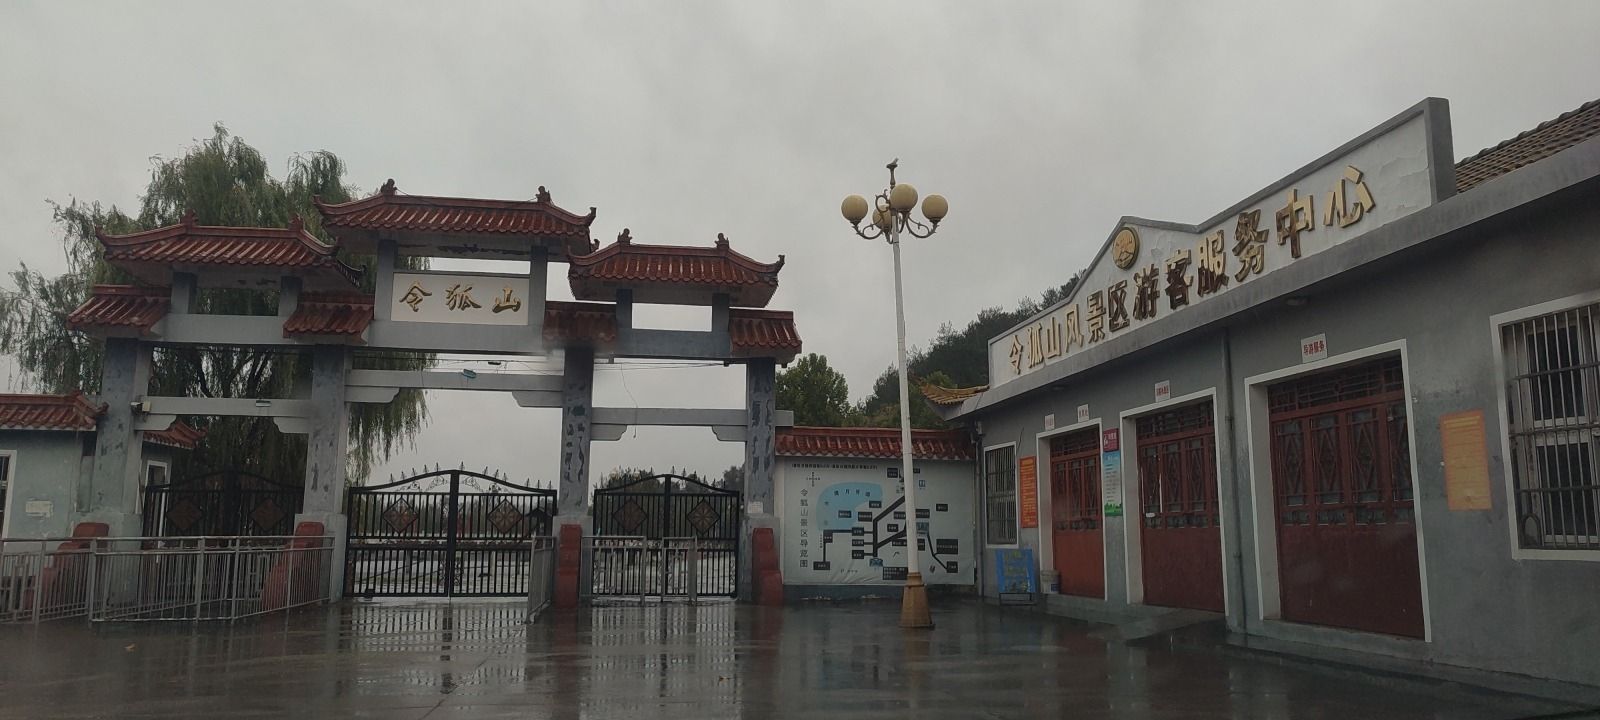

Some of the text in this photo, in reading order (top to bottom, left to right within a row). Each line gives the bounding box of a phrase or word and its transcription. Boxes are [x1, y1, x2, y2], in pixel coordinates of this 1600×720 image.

[400, 281, 521, 313] 令狐山
[1009, 165, 1376, 375] 令狐山风景区游客服务中心
[1304, 340, 1324, 355] 导游服务
[800, 489, 808, 567] 令狐山景区导览图
